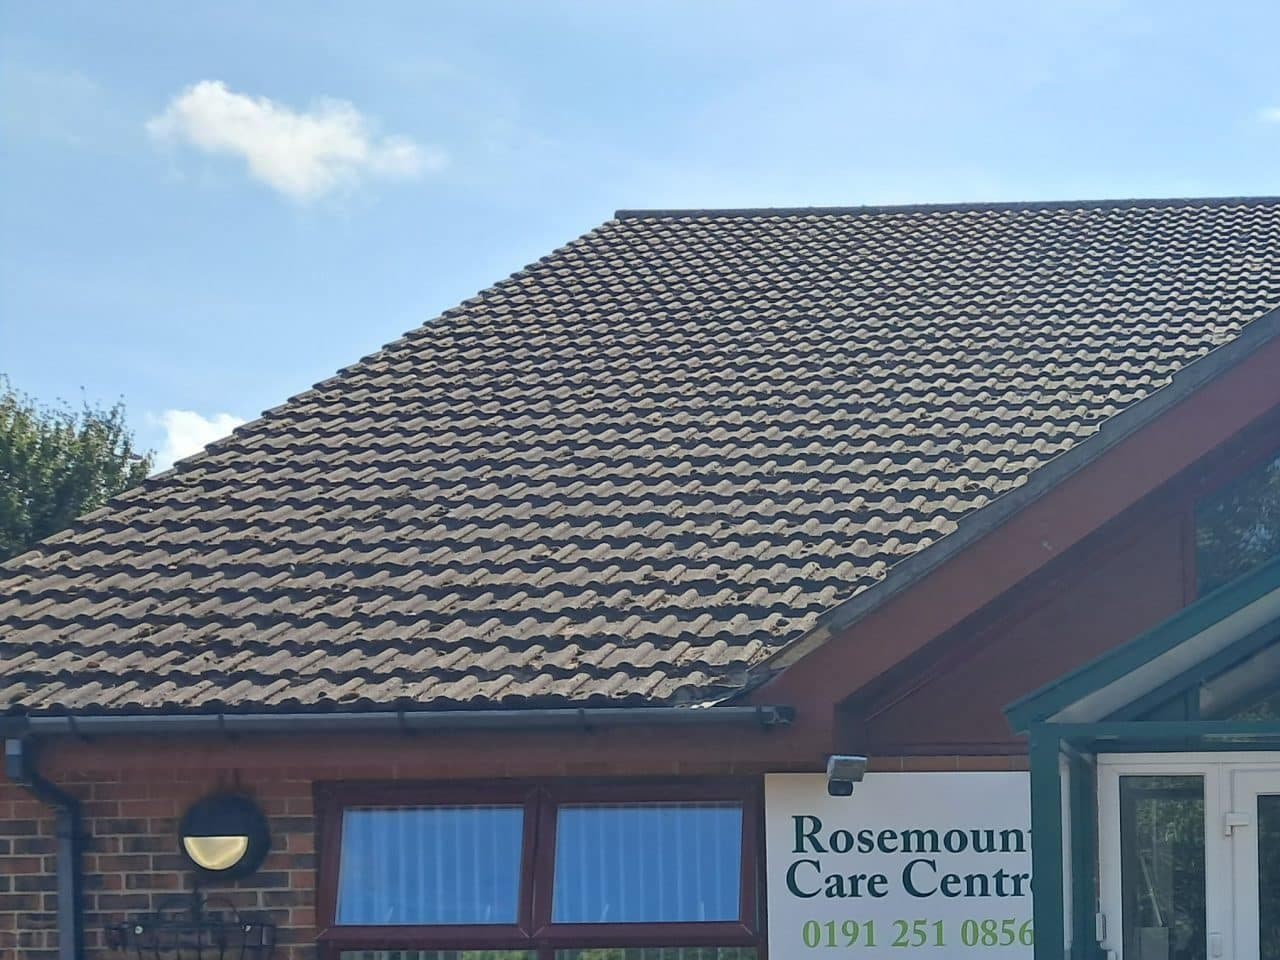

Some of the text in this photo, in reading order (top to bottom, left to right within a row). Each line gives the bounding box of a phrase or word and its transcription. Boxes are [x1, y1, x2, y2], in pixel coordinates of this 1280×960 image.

[791, 815, 1032, 853] Rosemoun
[786, 859, 1034, 898] Care Centr
[802, 918, 1034, 948] 0191 251 0856
